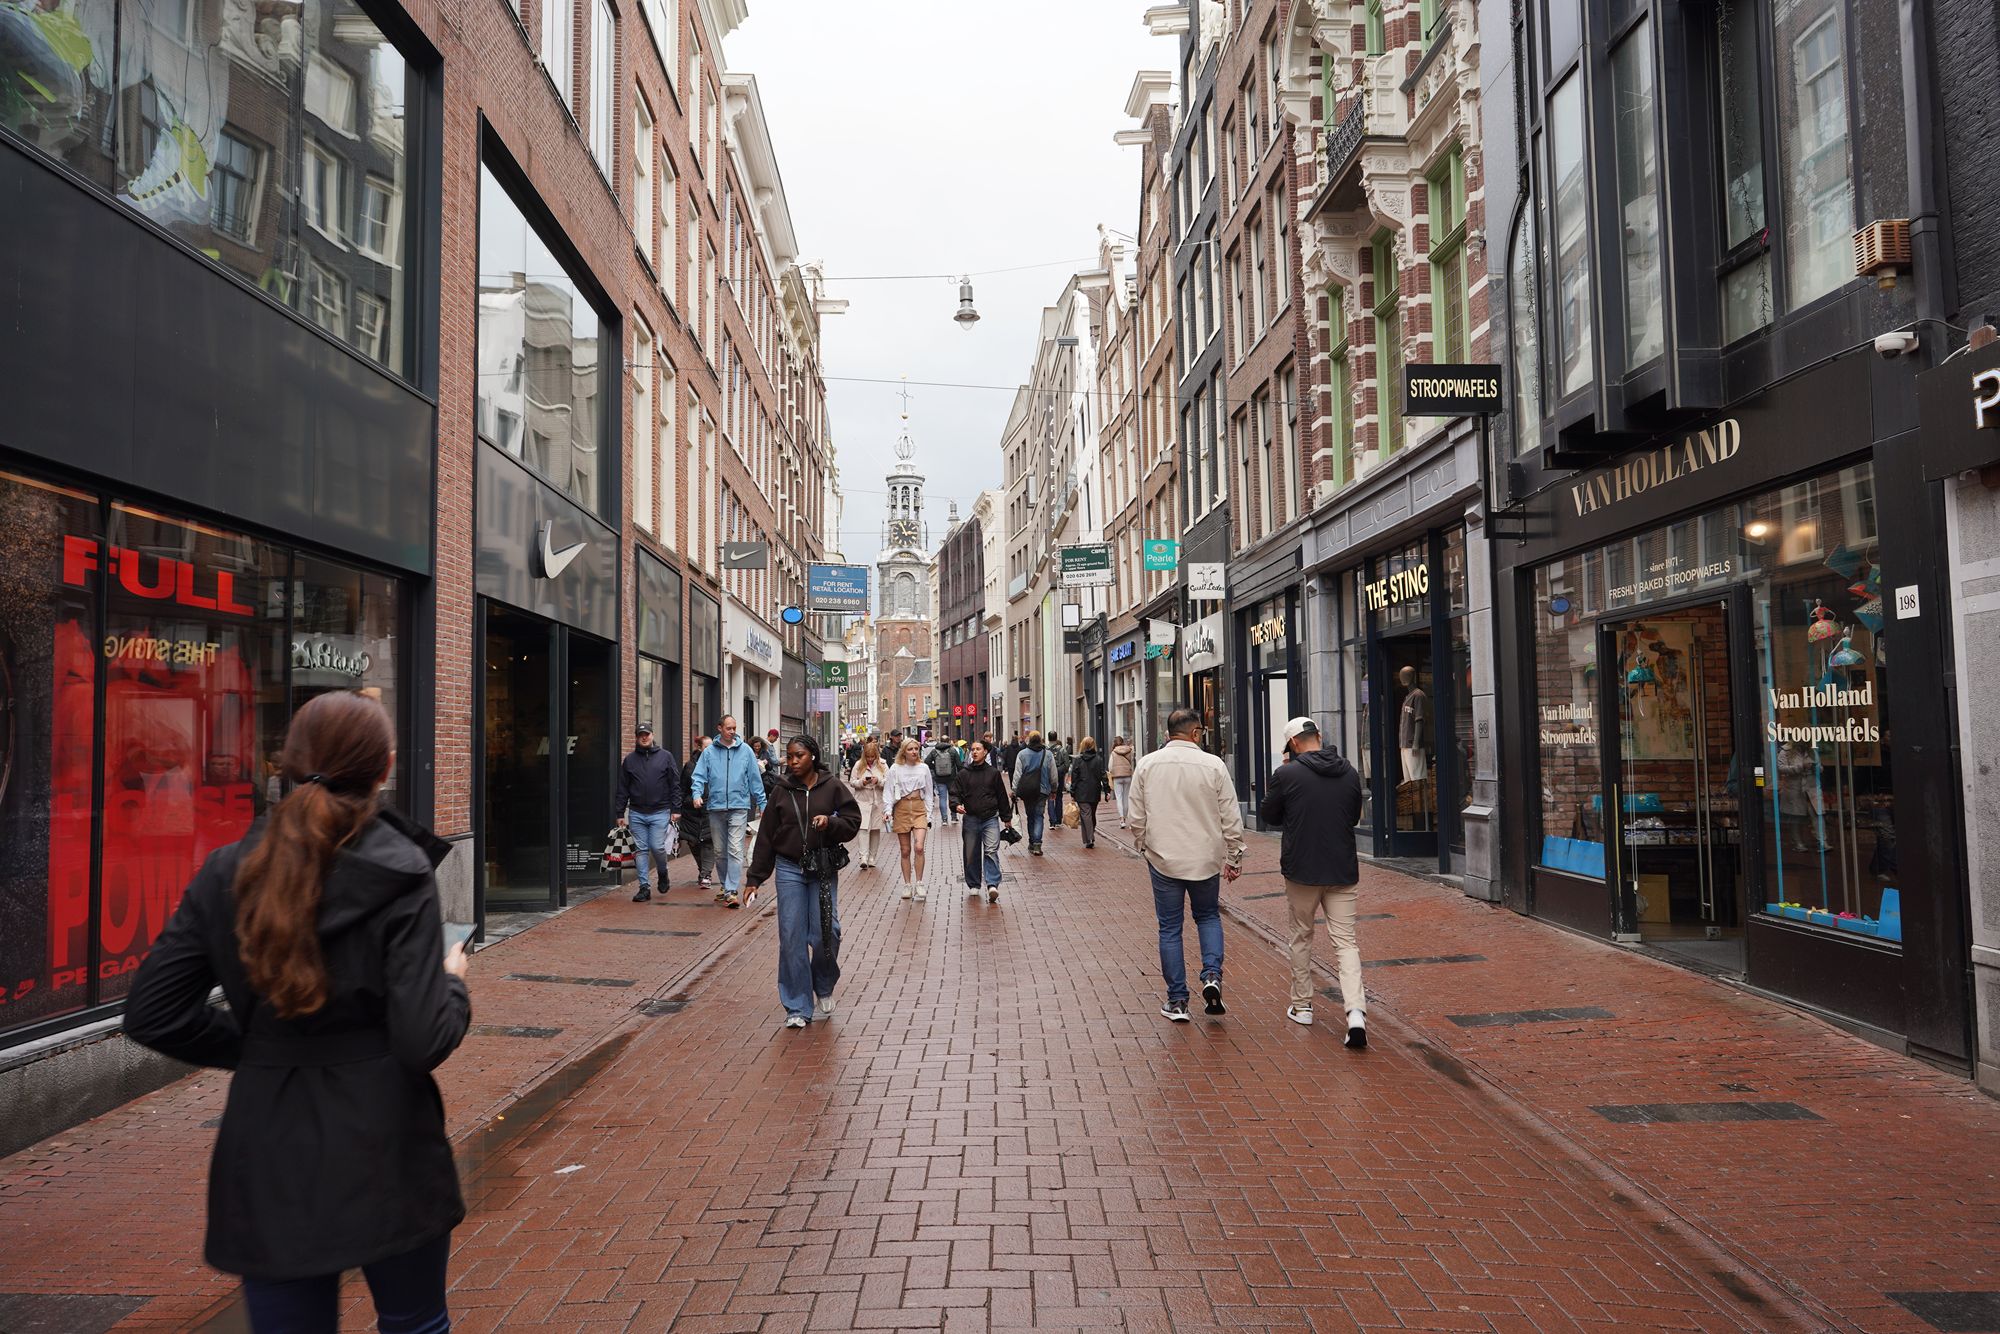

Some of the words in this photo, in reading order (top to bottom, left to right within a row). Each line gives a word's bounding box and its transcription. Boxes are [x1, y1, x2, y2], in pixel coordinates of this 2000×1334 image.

[1410, 378, 1498, 398] STROOPWAFELS
[1571, 471, 1611, 517] VAN
[1614, 418, 1741, 502] HOLLAND
[1146, 554, 1174, 563] Pearle
[1649, 562, 1665, 572] since
[1665, 556, 1678, 568] 1971
[63, 534, 255, 616] FULL
[1608, 583, 1638, 600] FRESHLY
[1639, 577, 1663, 593] BAKED
[1664, 560, 1731, 587] STROOPWAFELS
[812, 585, 833, 593] RETAIL
[1365, 578, 1389, 611] THE
[1389, 563, 1429, 603] STING
[828, 597, 841, 605] 238
[1899, 593, 1916, 611] 198
[1250, 622, 1264, 647] THE
[1263, 615, 1286, 642] STING
[1769, 687, 1800, 710] Van
[1801, 680, 1873, 708] Holland
[1541, 705, 1558, 721] Van
[1558, 701, 1593, 720] Holland
[1541, 726, 1597, 748] Stroopwafels
[1767, 717, 1880, 749] Stroopwafels
